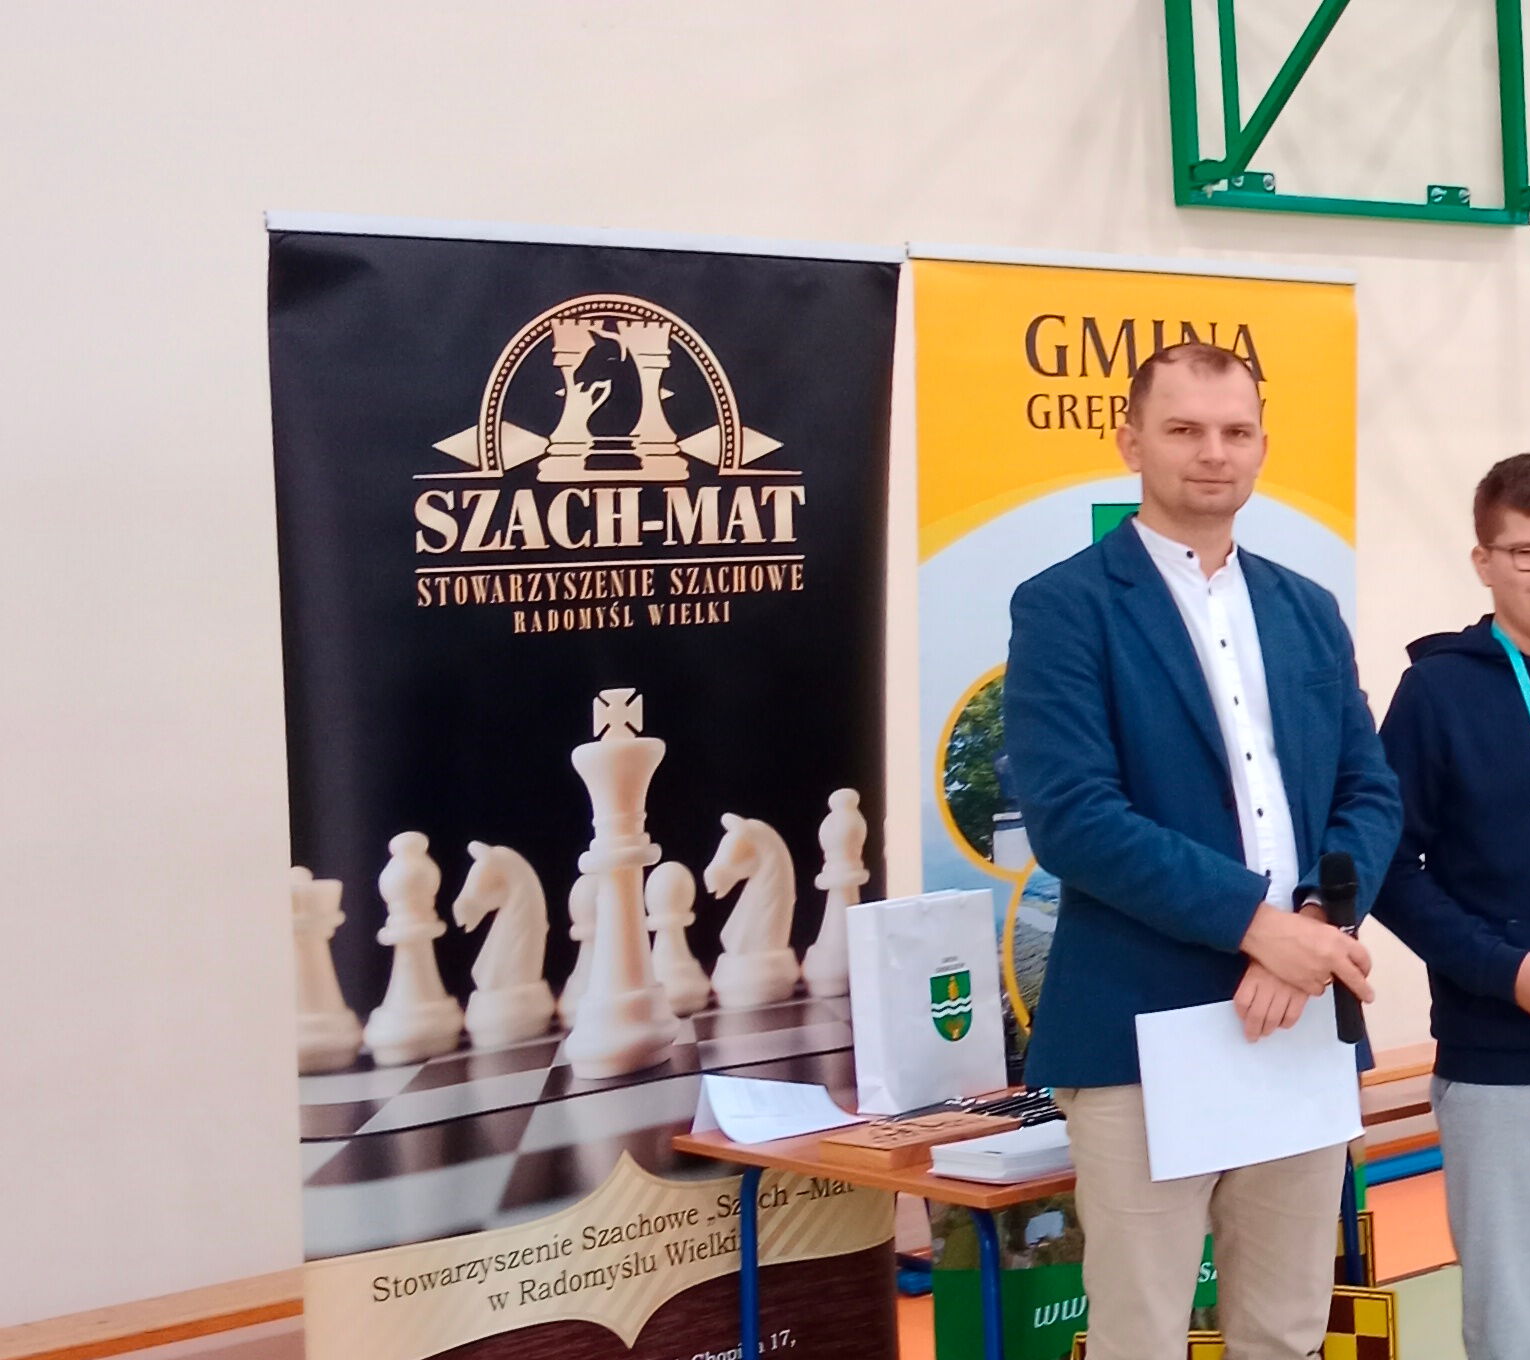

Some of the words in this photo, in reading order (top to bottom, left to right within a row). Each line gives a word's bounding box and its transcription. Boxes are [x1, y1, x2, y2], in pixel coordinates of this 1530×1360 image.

[414, 485, 806, 555] SZACH-MAT
[417, 567, 655, 608] STOWARZYSZENIE
[670, 563, 805, 597] SZACHOWE
[513, 601, 635, 635] RADOMYŚL
[647, 600, 732, 627] WIELKI
[372, 1233, 573, 1303] Stowarzyszenie
[582, 1207, 699, 1251] Szachowe
[488, 1289, 510, 1312] w
[518, 1250, 657, 1307] Radomyślu
[770, 1328, 797, 1352] 17,
